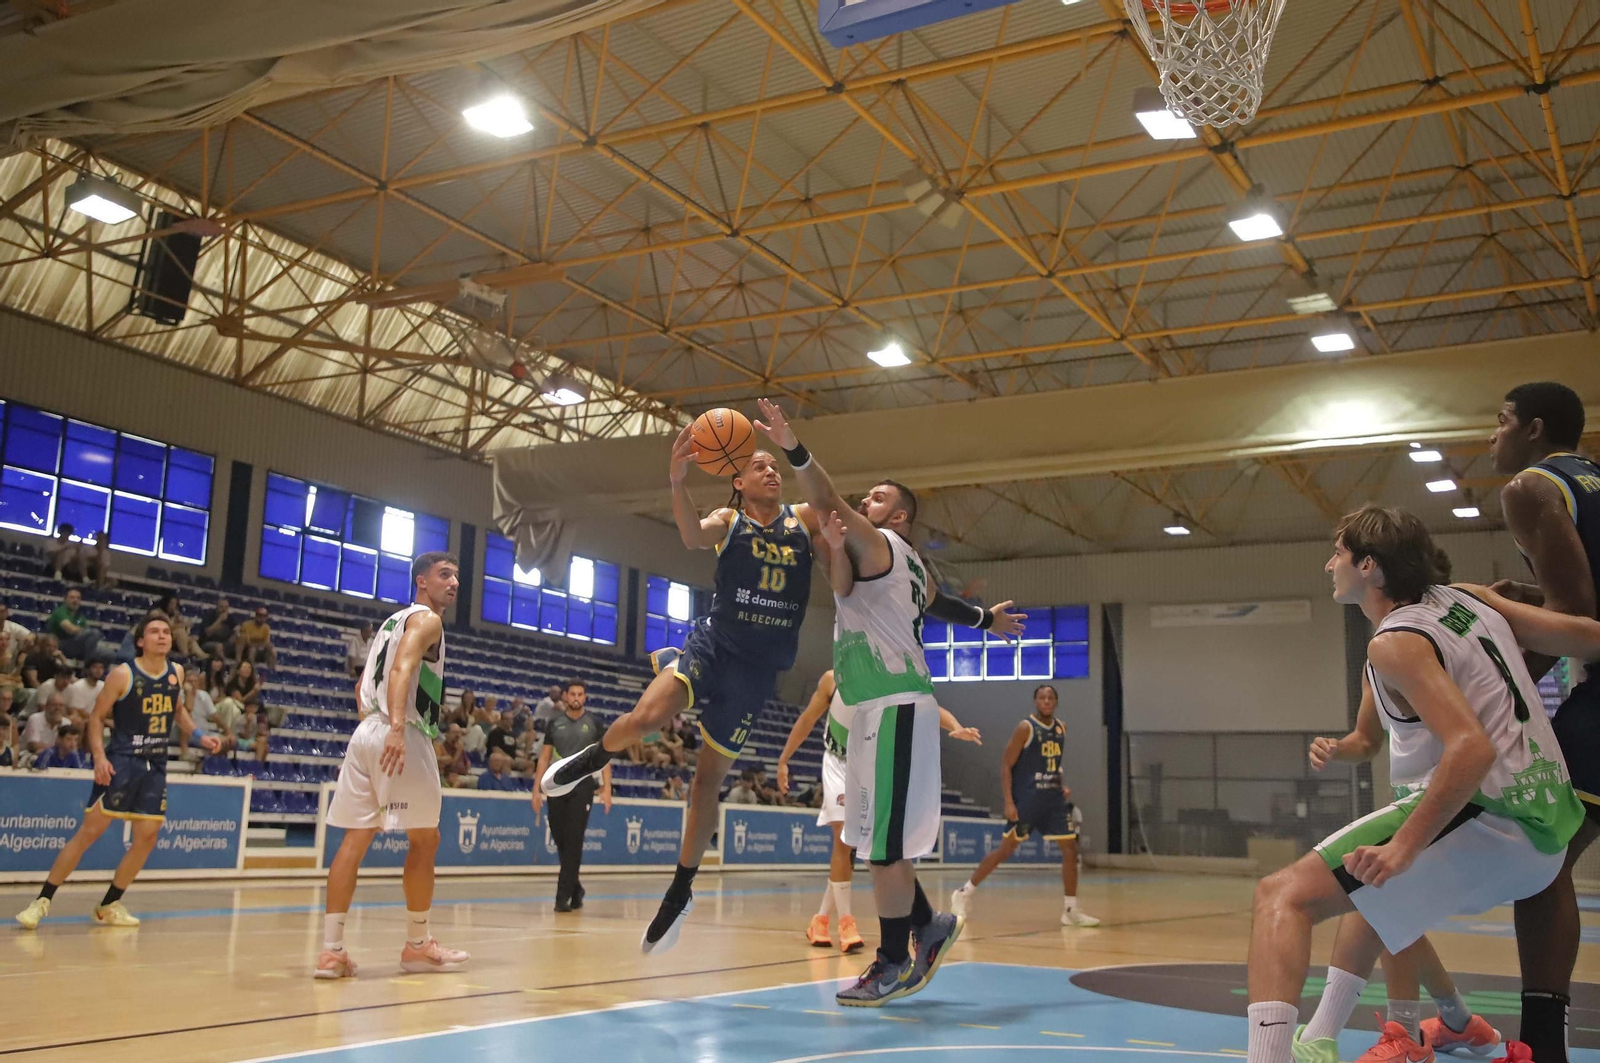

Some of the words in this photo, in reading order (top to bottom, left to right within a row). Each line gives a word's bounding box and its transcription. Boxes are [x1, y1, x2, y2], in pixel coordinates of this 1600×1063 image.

[752, 537, 797, 566] CBA
[757, 565, 786, 592] 10
[737, 611, 793, 628] ALGECIRAS
[142, 693, 173, 715] CBA
[148, 715, 167, 734] 21
[729, 727, 747, 745] 10
[1041, 741, 1061, 757] CBA
[162, 818, 237, 834] Ayuntamiento
[0, 833, 66, 853] Algeciras
[157, 838, 170, 849] de
[173, 835, 228, 853] Algeciras
